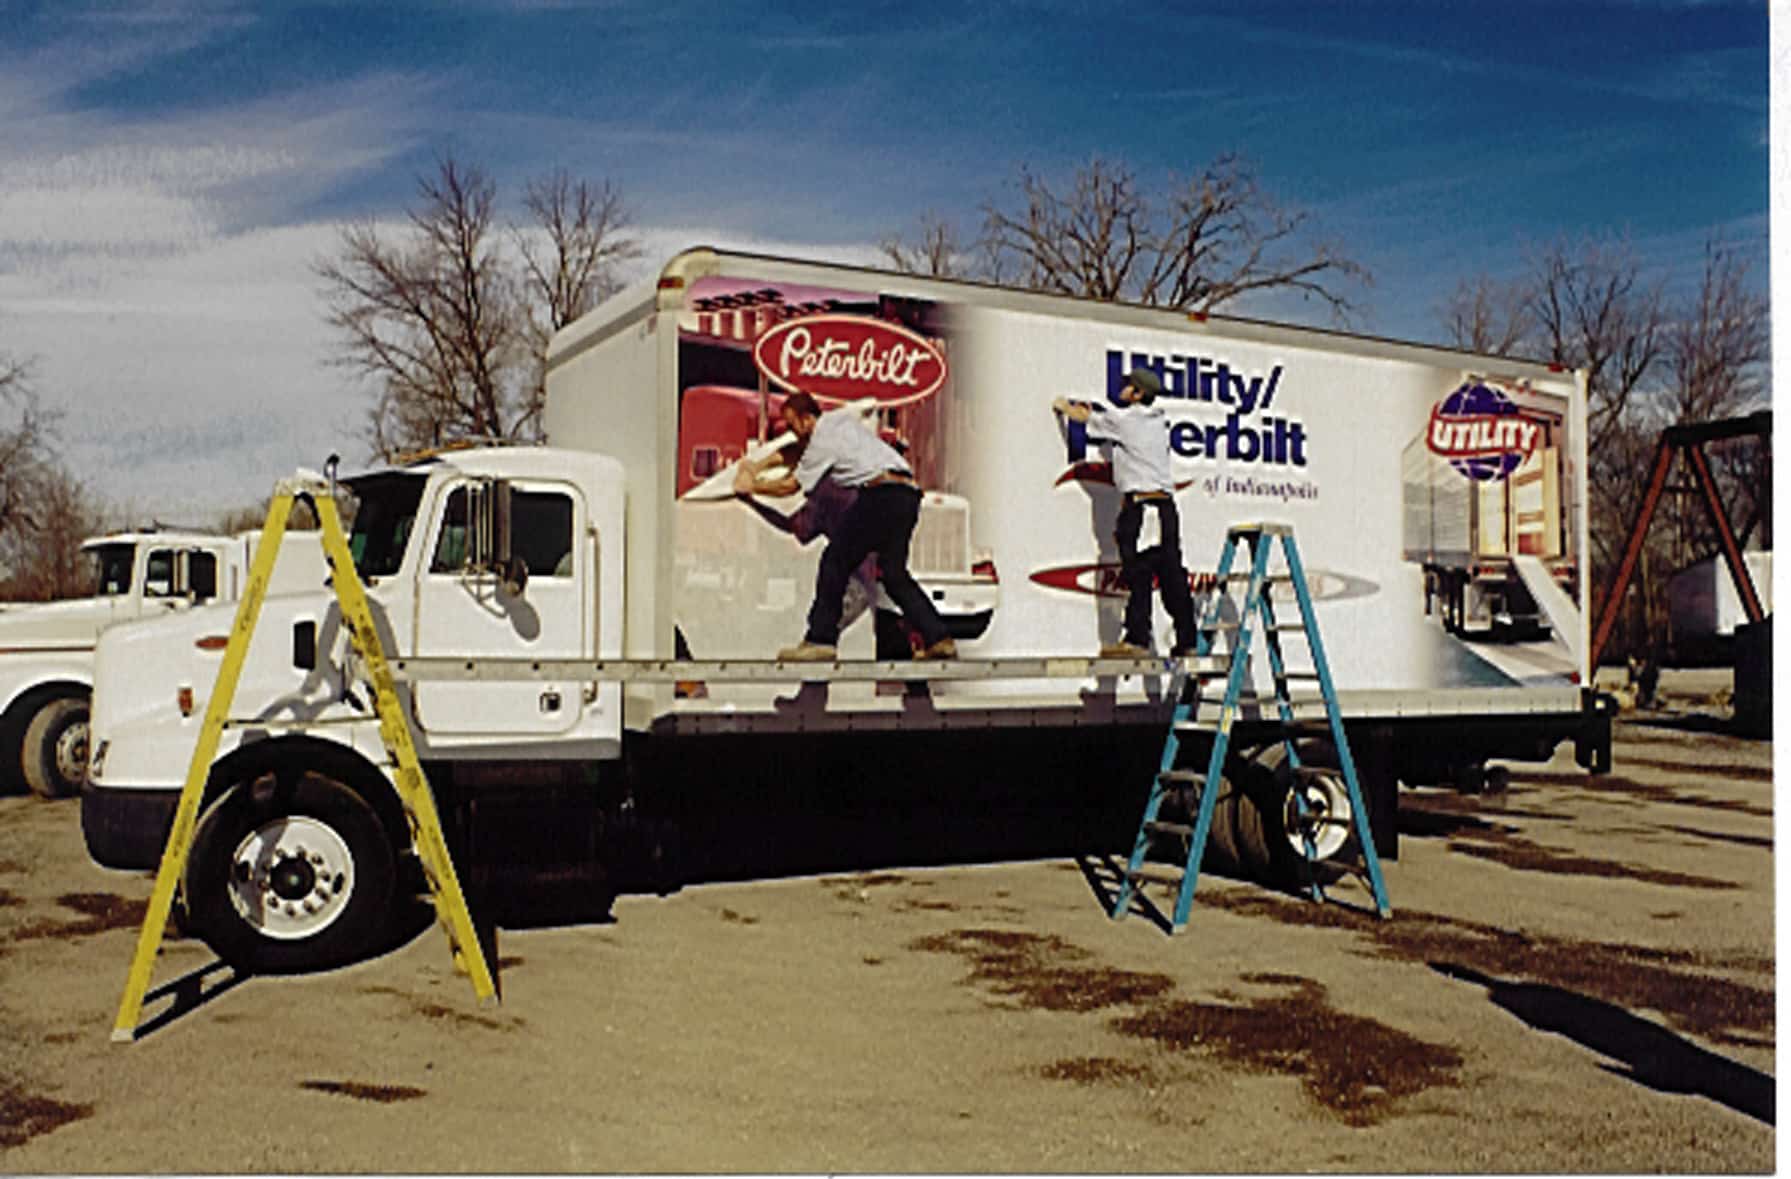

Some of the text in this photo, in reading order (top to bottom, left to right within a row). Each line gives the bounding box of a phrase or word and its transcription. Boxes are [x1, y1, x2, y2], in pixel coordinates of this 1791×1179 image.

[781, 328, 931, 385] Peterbilt
[1067, 399, 1307, 466] Perbilt
[1432, 419, 1537, 451] UTILITY
